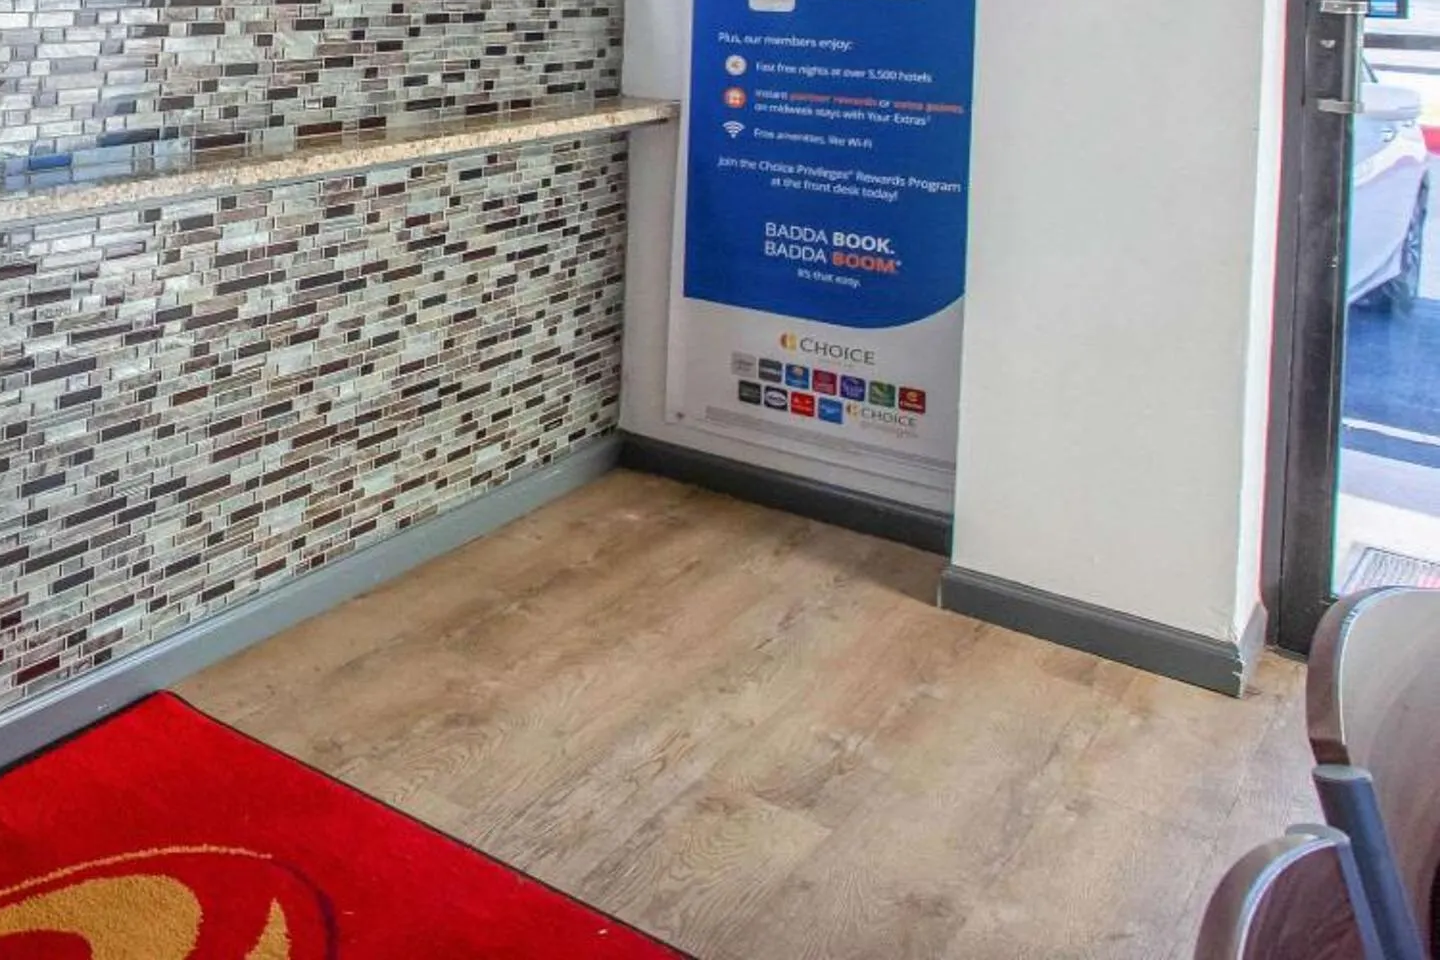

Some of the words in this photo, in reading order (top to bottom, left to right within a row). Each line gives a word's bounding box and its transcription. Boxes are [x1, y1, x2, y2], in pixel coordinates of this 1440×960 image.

[764, 35, 817, 48] members
[867, 111, 891, 122] Your
[758, 160, 795, 174] Choice
[856, 171, 906, 187] Rewards
[907, 176, 962, 193] Program
[764, 221, 829, 245] BADDA
[832, 231, 896, 254] BOOK.
[763, 240, 827, 264] BADDA
[800, 337, 876, 366] CHOICE
[861, 406, 918, 427] CHOICE
